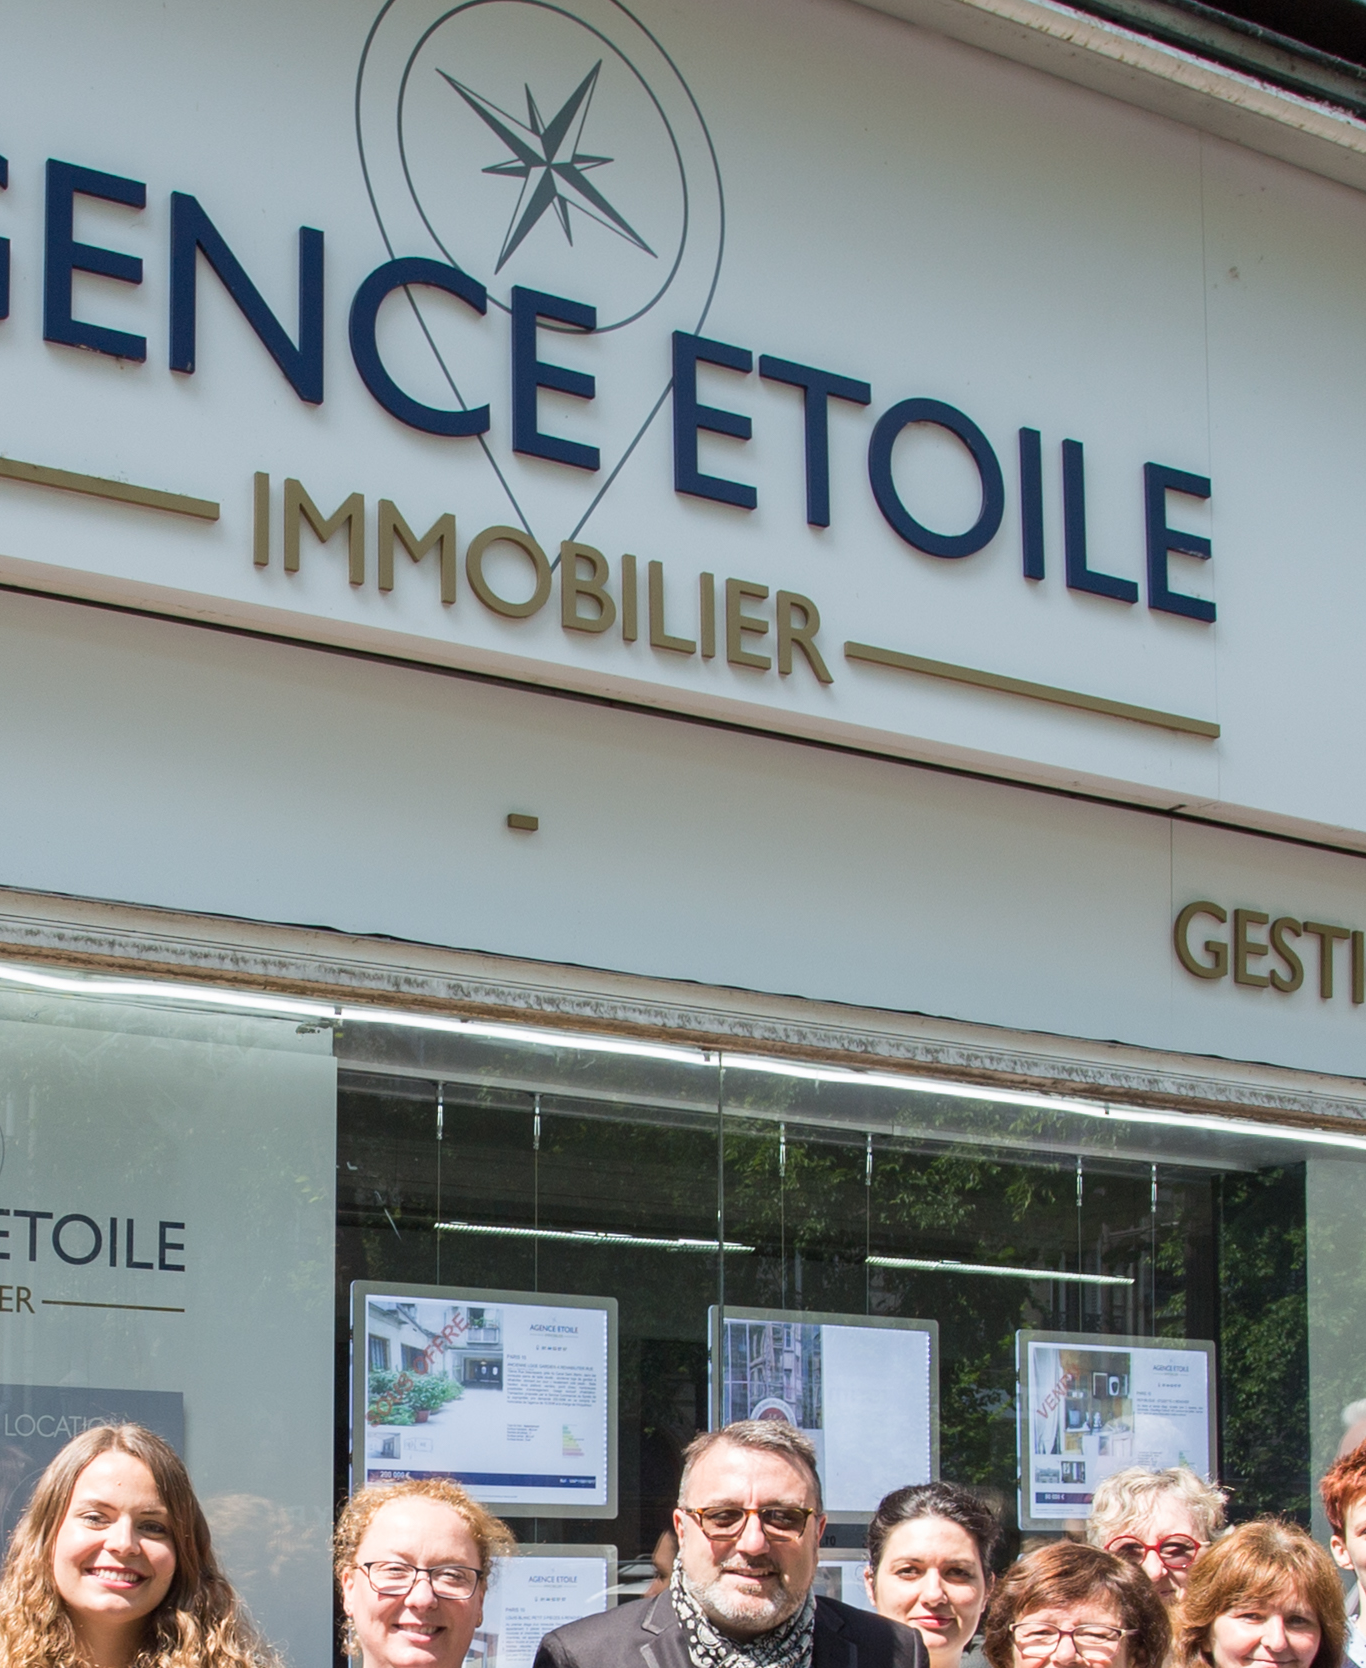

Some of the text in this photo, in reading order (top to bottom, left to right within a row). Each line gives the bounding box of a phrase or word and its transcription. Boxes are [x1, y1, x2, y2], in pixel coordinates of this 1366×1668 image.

[669, 327, 1219, 623] ETOILE
[251, 469, 836, 685] IMMOBILIER
[365, 1311, 470, 1428] SOUS OFFRE
[528, 1575, 578, 1583] AGENCE ETOILE
